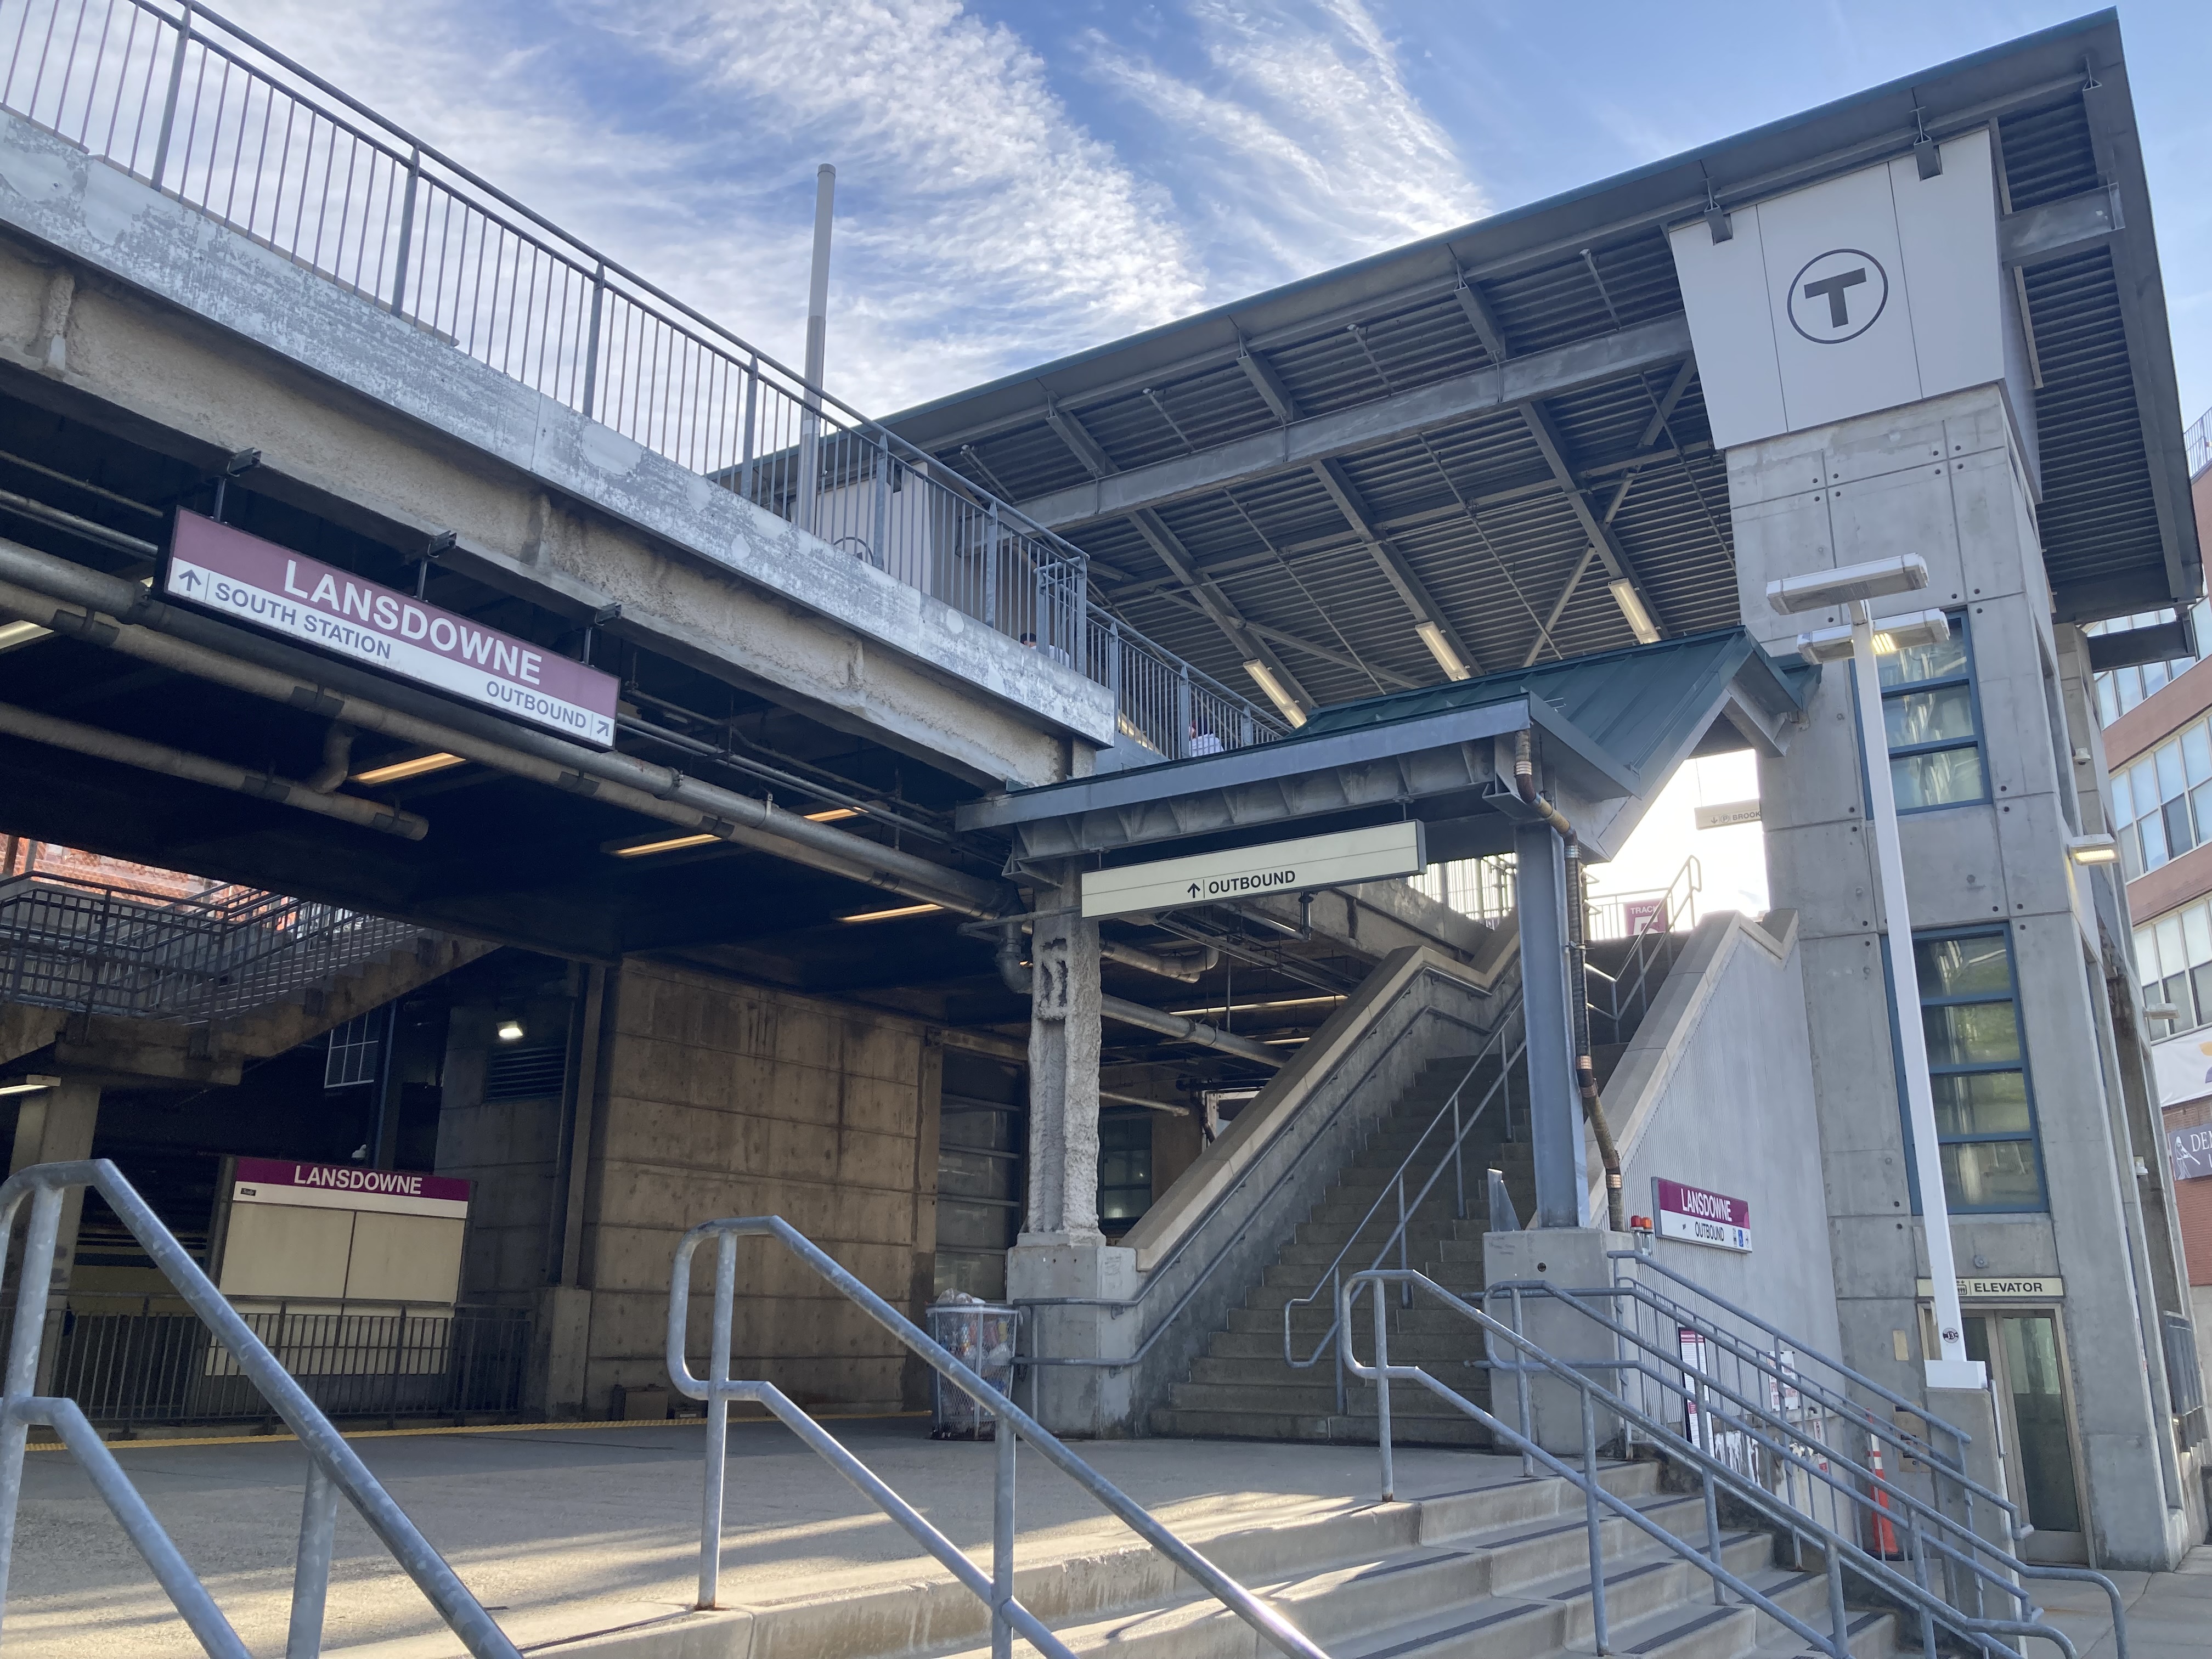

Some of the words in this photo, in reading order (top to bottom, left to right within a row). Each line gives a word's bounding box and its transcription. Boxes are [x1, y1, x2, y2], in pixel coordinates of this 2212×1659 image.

[1804, 268, 1866, 328] T
[215, 582, 297, 627] SOUTH
[304, 614, 391, 659] STATION
[284, 560, 544, 686] LANSDOWNE
[487, 680, 587, 730] OUTBOUND
[1209, 870, 1295, 895] OUTBOUND
[294, 1165, 422, 1195] LANSDOWNE
[1680, 1188, 1733, 1222] LANSDOWNE
[1695, 1221, 1724, 1242] OUTBOUND
[1974, 1282, 2043, 1293] ELEVATOR
